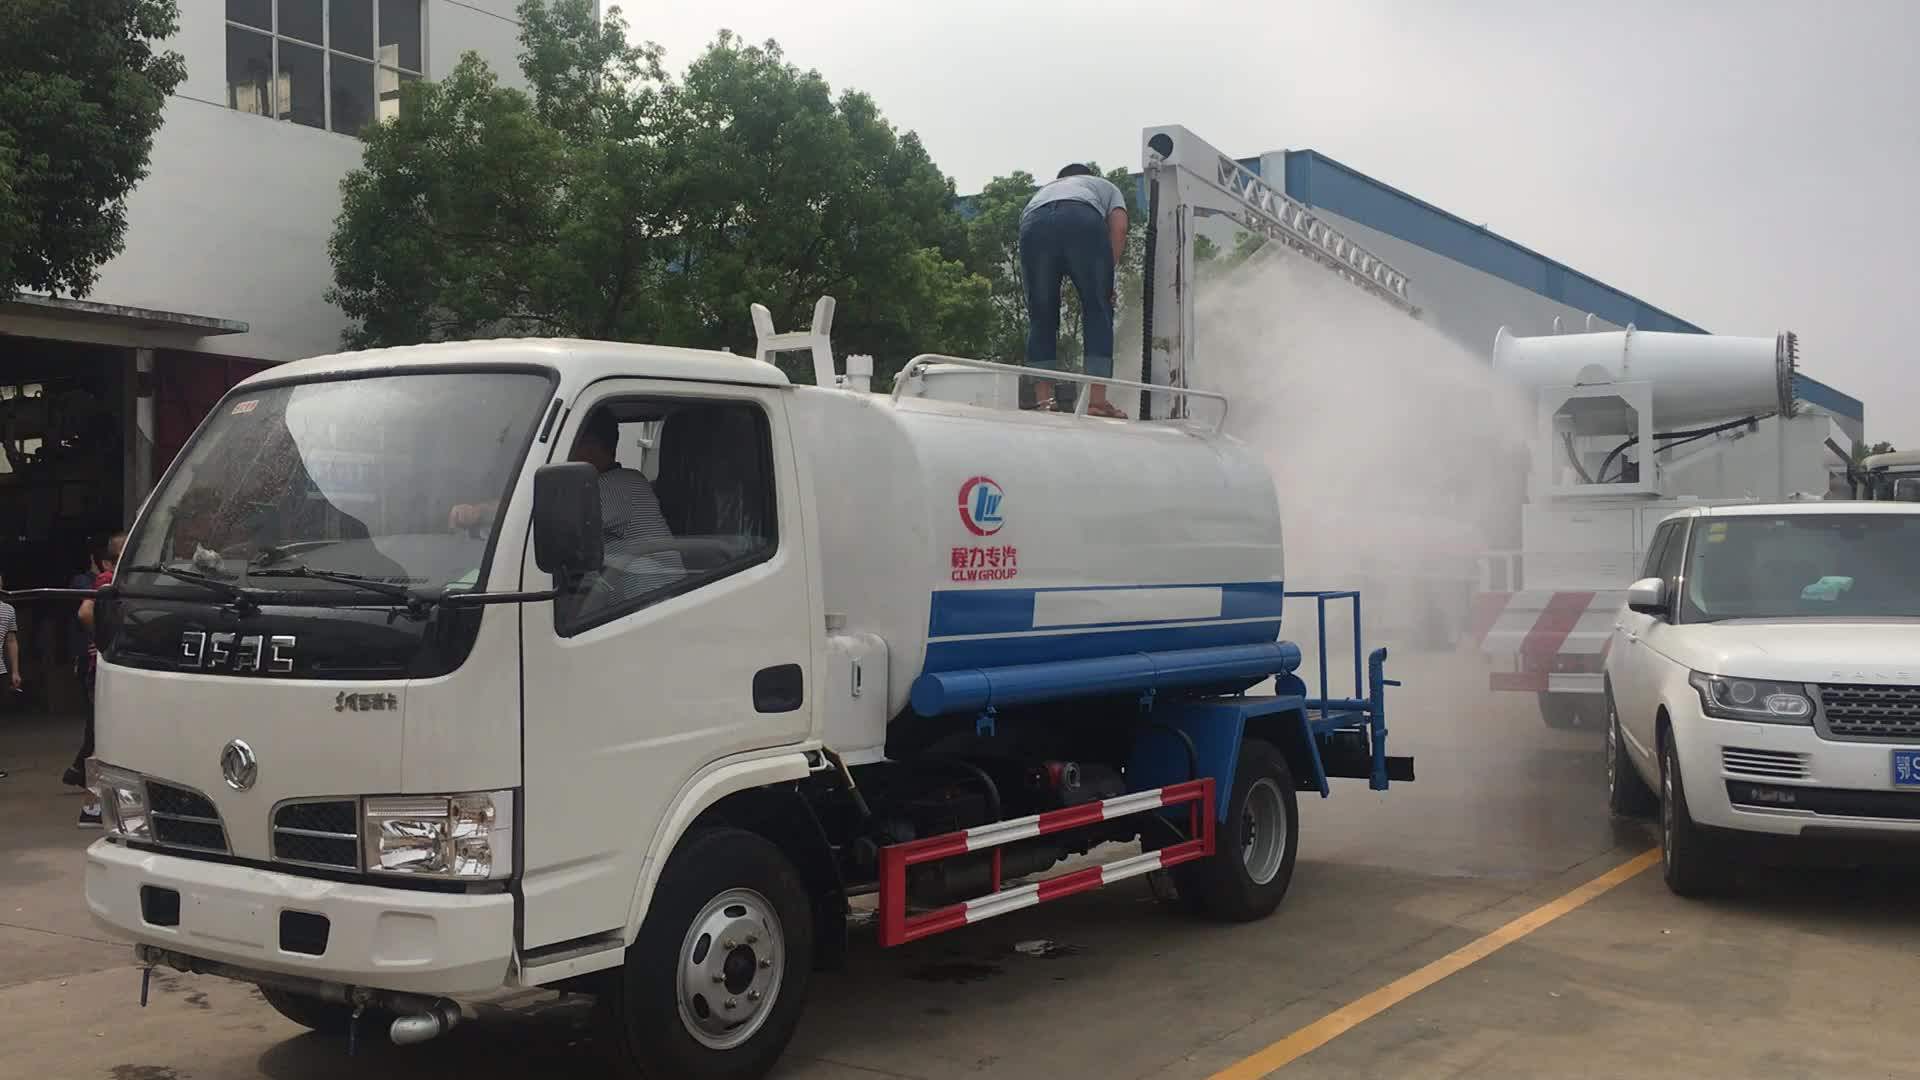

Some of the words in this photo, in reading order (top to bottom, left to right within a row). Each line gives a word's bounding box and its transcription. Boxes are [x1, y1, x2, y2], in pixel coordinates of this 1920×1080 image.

[951, 545, 1017, 568] 程力专汽
[978, 568, 1018, 581] GROUP
